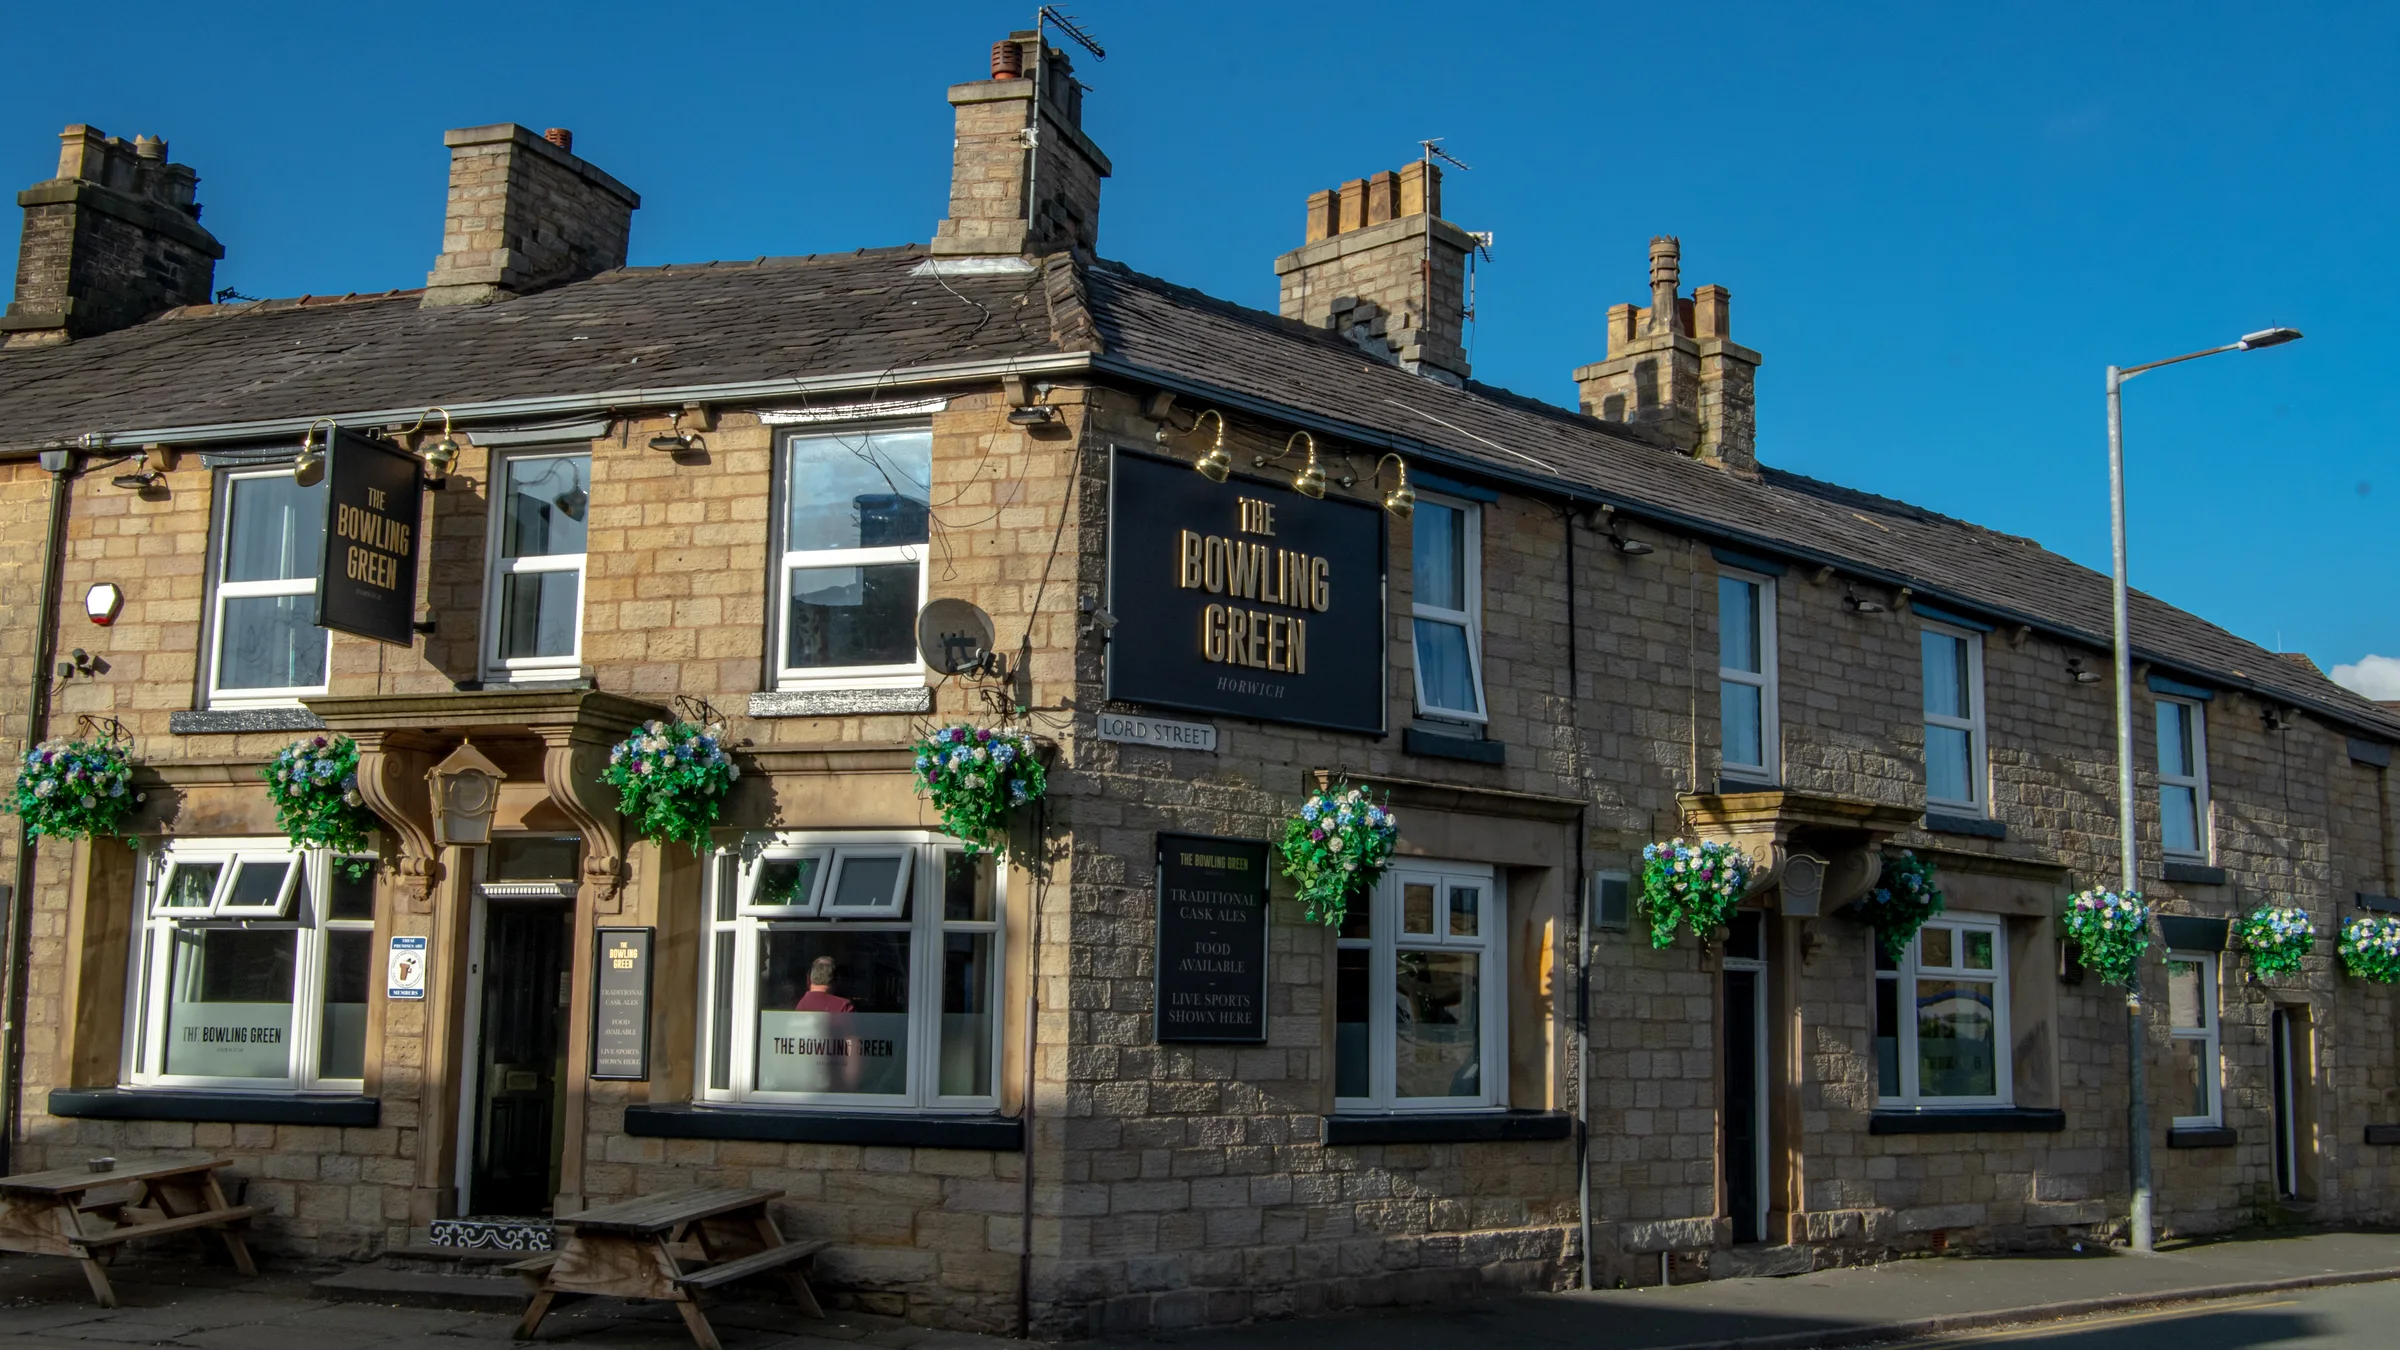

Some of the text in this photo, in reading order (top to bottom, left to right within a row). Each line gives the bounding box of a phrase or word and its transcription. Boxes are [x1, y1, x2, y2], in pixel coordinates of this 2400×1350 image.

[368, 487, 386, 511] THE
[1239, 496, 1276, 536] THE
[337, 503, 410, 556] BOWLING
[347, 545, 397, 591] GREEN
[1180, 529, 1330, 613] BOWLING
[1204, 603, 1306, 674] GREEN
[1217, 677, 1285, 698] HORWICH
[1103, 718, 1210, 745] LORD STREET
[1180, 852, 1249, 871] THE BOWLING GREEN
[1170, 888, 1257, 907] TRADITIONAL
[1180, 906, 1247, 923] CASK ALES
[609, 948, 638, 959] BOWLING
[1195, 941, 1231, 956] FOOD
[613, 958, 633, 969] GREEN
[1179, 958, 1245, 973] AVAILABLE
[1172, 992, 1250, 1007] LIVE SPORTS
[1168, 1010, 1252, 1024] SHOWN HERE
[202, 1026, 247, 1043] BOWLING
[250, 1027, 282, 1043] GREEN
[774, 1037, 893, 1057] THE BOWLING GREEN
